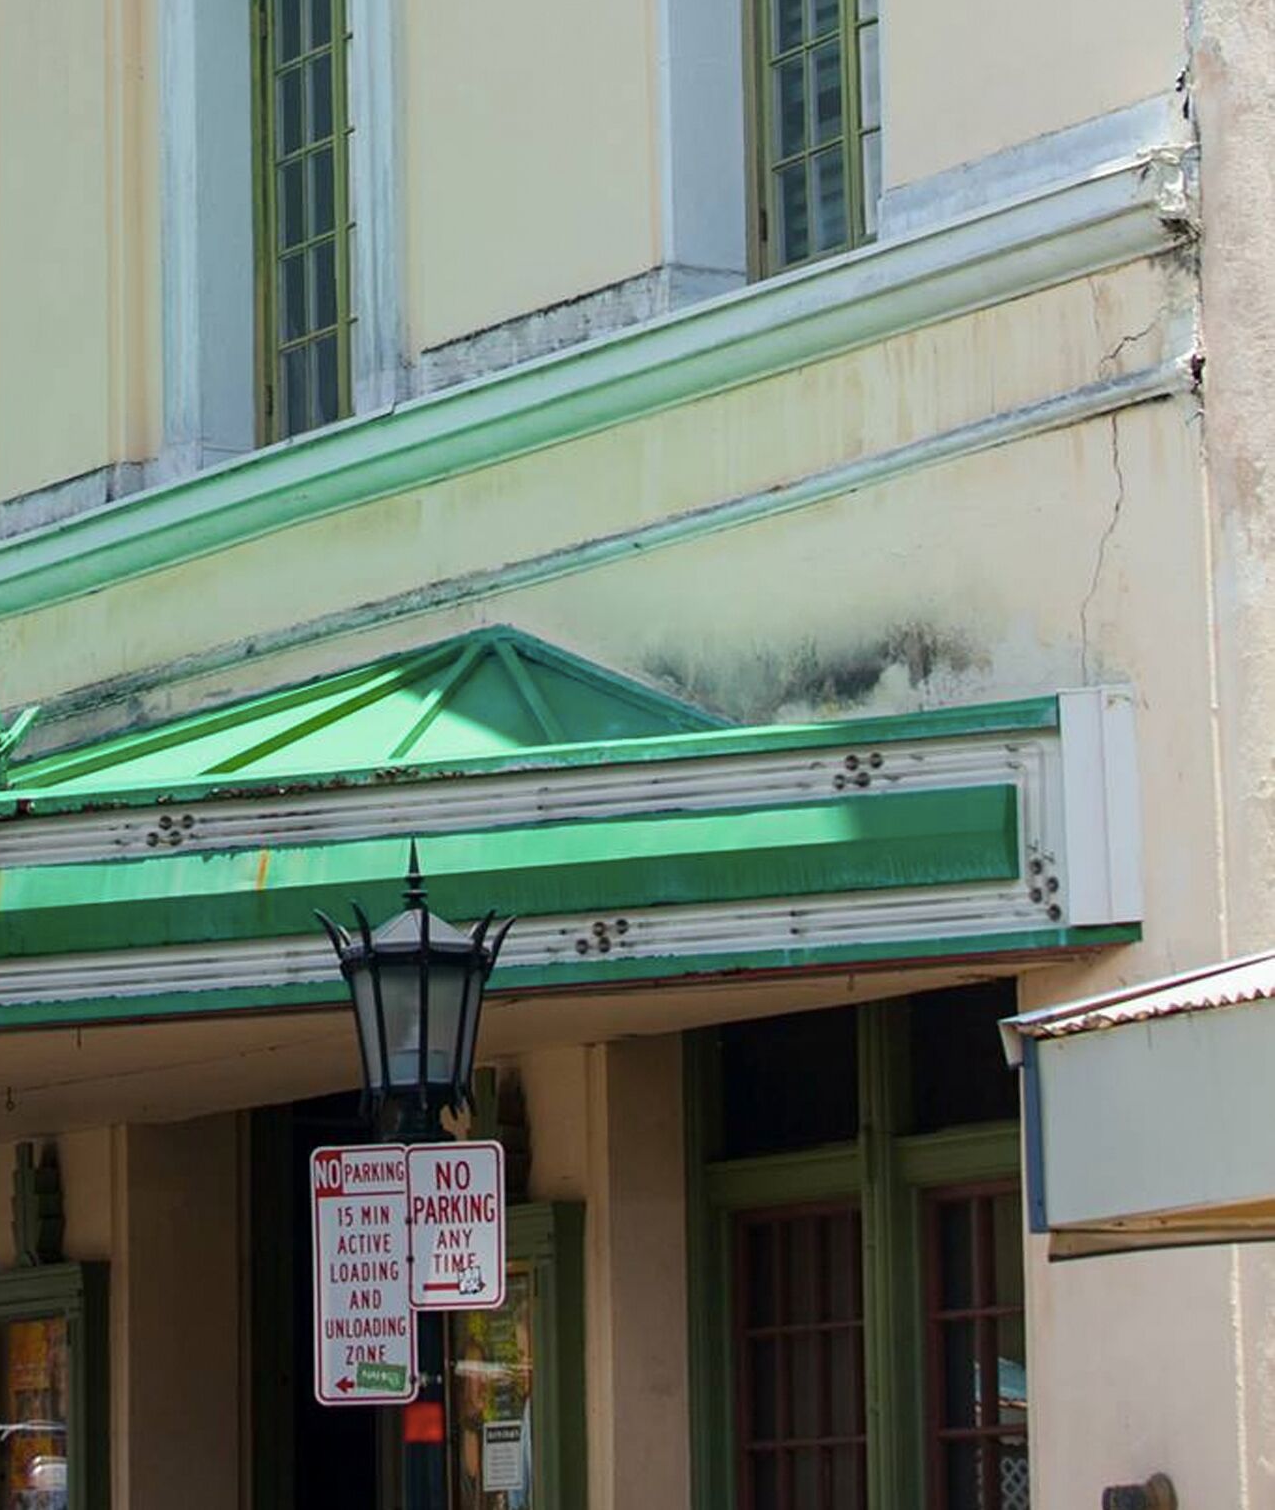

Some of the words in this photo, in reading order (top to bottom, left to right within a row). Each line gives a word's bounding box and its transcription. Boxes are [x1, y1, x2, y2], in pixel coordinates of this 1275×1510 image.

[315, 1159, 340, 1189] NO
[344, 1161, 404, 1183] PARKING
[435, 1161, 470, 1191] NO
[338, 1207, 354, 1226] 15
[361, 1206, 390, 1225] MIN
[413, 1193, 495, 1225] PARKING
[337, 1233, 391, 1254] ACTIVE
[436, 1228, 472, 1250] ANY
[330, 1261, 399, 1283] LOADING
[433, 1252, 476, 1274] TIME
[349, 1289, 382, 1310] AND
[325, 1316, 406, 1339] UNLOADING
[346, 1344, 386, 1366] ZONE
